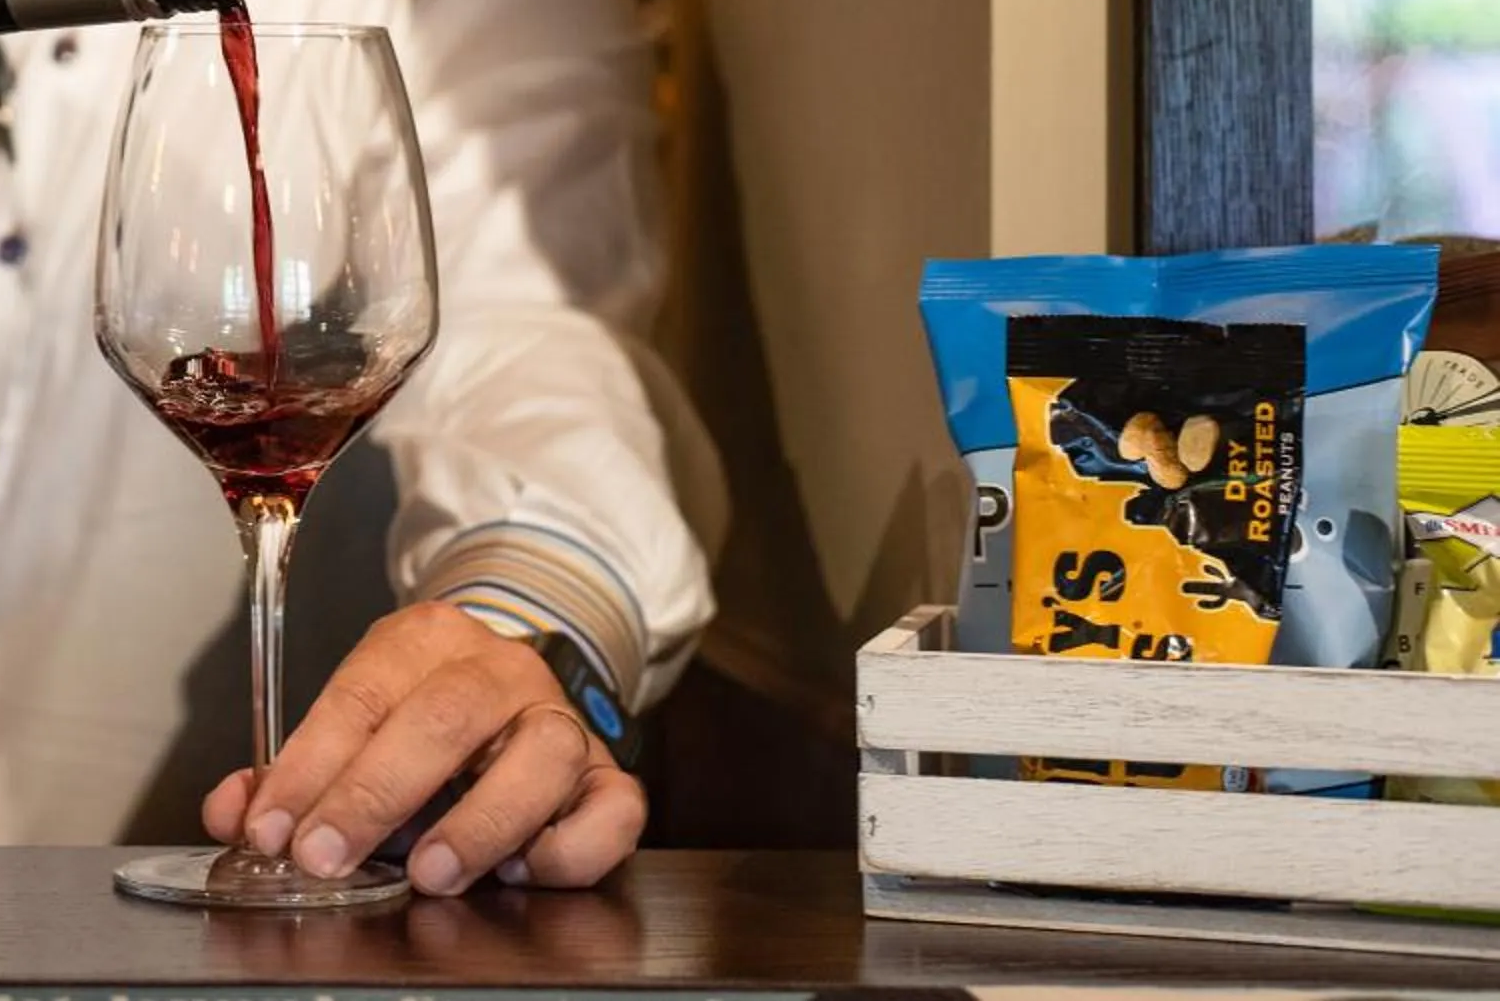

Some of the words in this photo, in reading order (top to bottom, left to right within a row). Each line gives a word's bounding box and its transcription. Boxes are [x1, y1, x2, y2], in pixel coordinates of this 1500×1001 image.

[1225, 439, 1248, 502] DRY
[1248, 402, 1276, 542] ROASTED
[1278, 432, 1296, 515] PEANUTS
